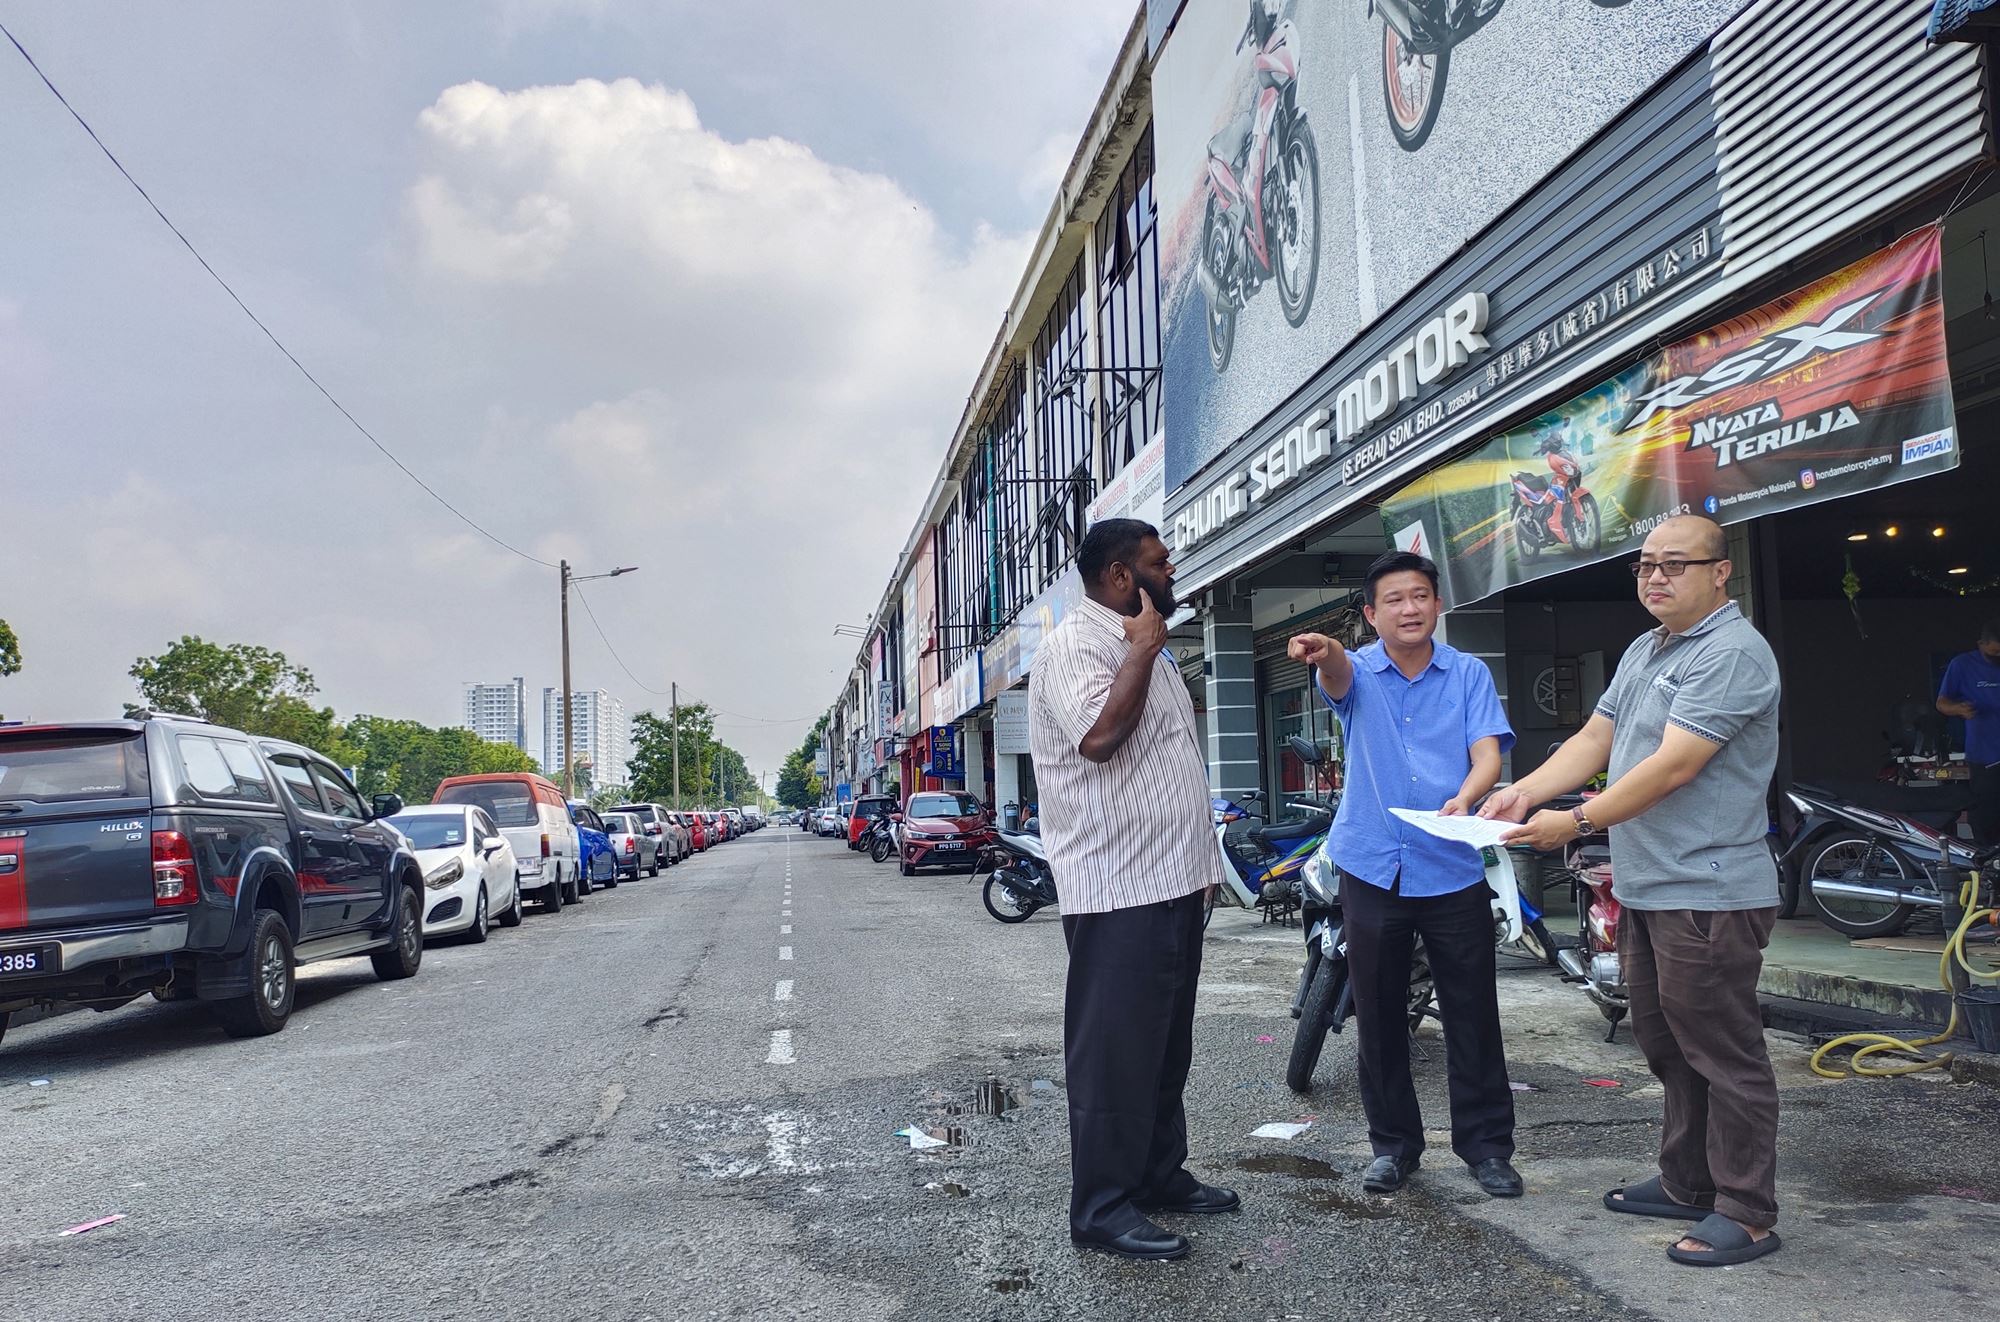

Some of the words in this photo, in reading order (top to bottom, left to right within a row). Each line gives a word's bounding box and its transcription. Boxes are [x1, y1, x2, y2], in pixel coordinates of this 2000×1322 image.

[1624, 291, 1883, 430] RS-X
[1174, 472, 1247, 551] CHUNG
[1250, 409, 1331, 502] SENG
[1336, 292, 1490, 443] MOTOR
[1354, 435, 1388, 472] PERAI)
[1389, 424, 1414, 450] SDN.
[1416, 400, 1446, 433] BHD.
[1691, 402, 1780, 448] NYATA
[1712, 405, 1861, 468] TERUJA
[1815, 453, 1893, 480] hondamotorcycle.my
[1905, 437, 1953, 460] IMPIAN
[1719, 496, 1738, 507] Honda
[1737, 487, 1769, 502] Motorcycle
[1768, 480, 1797, 495] Malaysia
[100, 821, 144, 832] HILUX
[0, 953, 36, 972] 385
